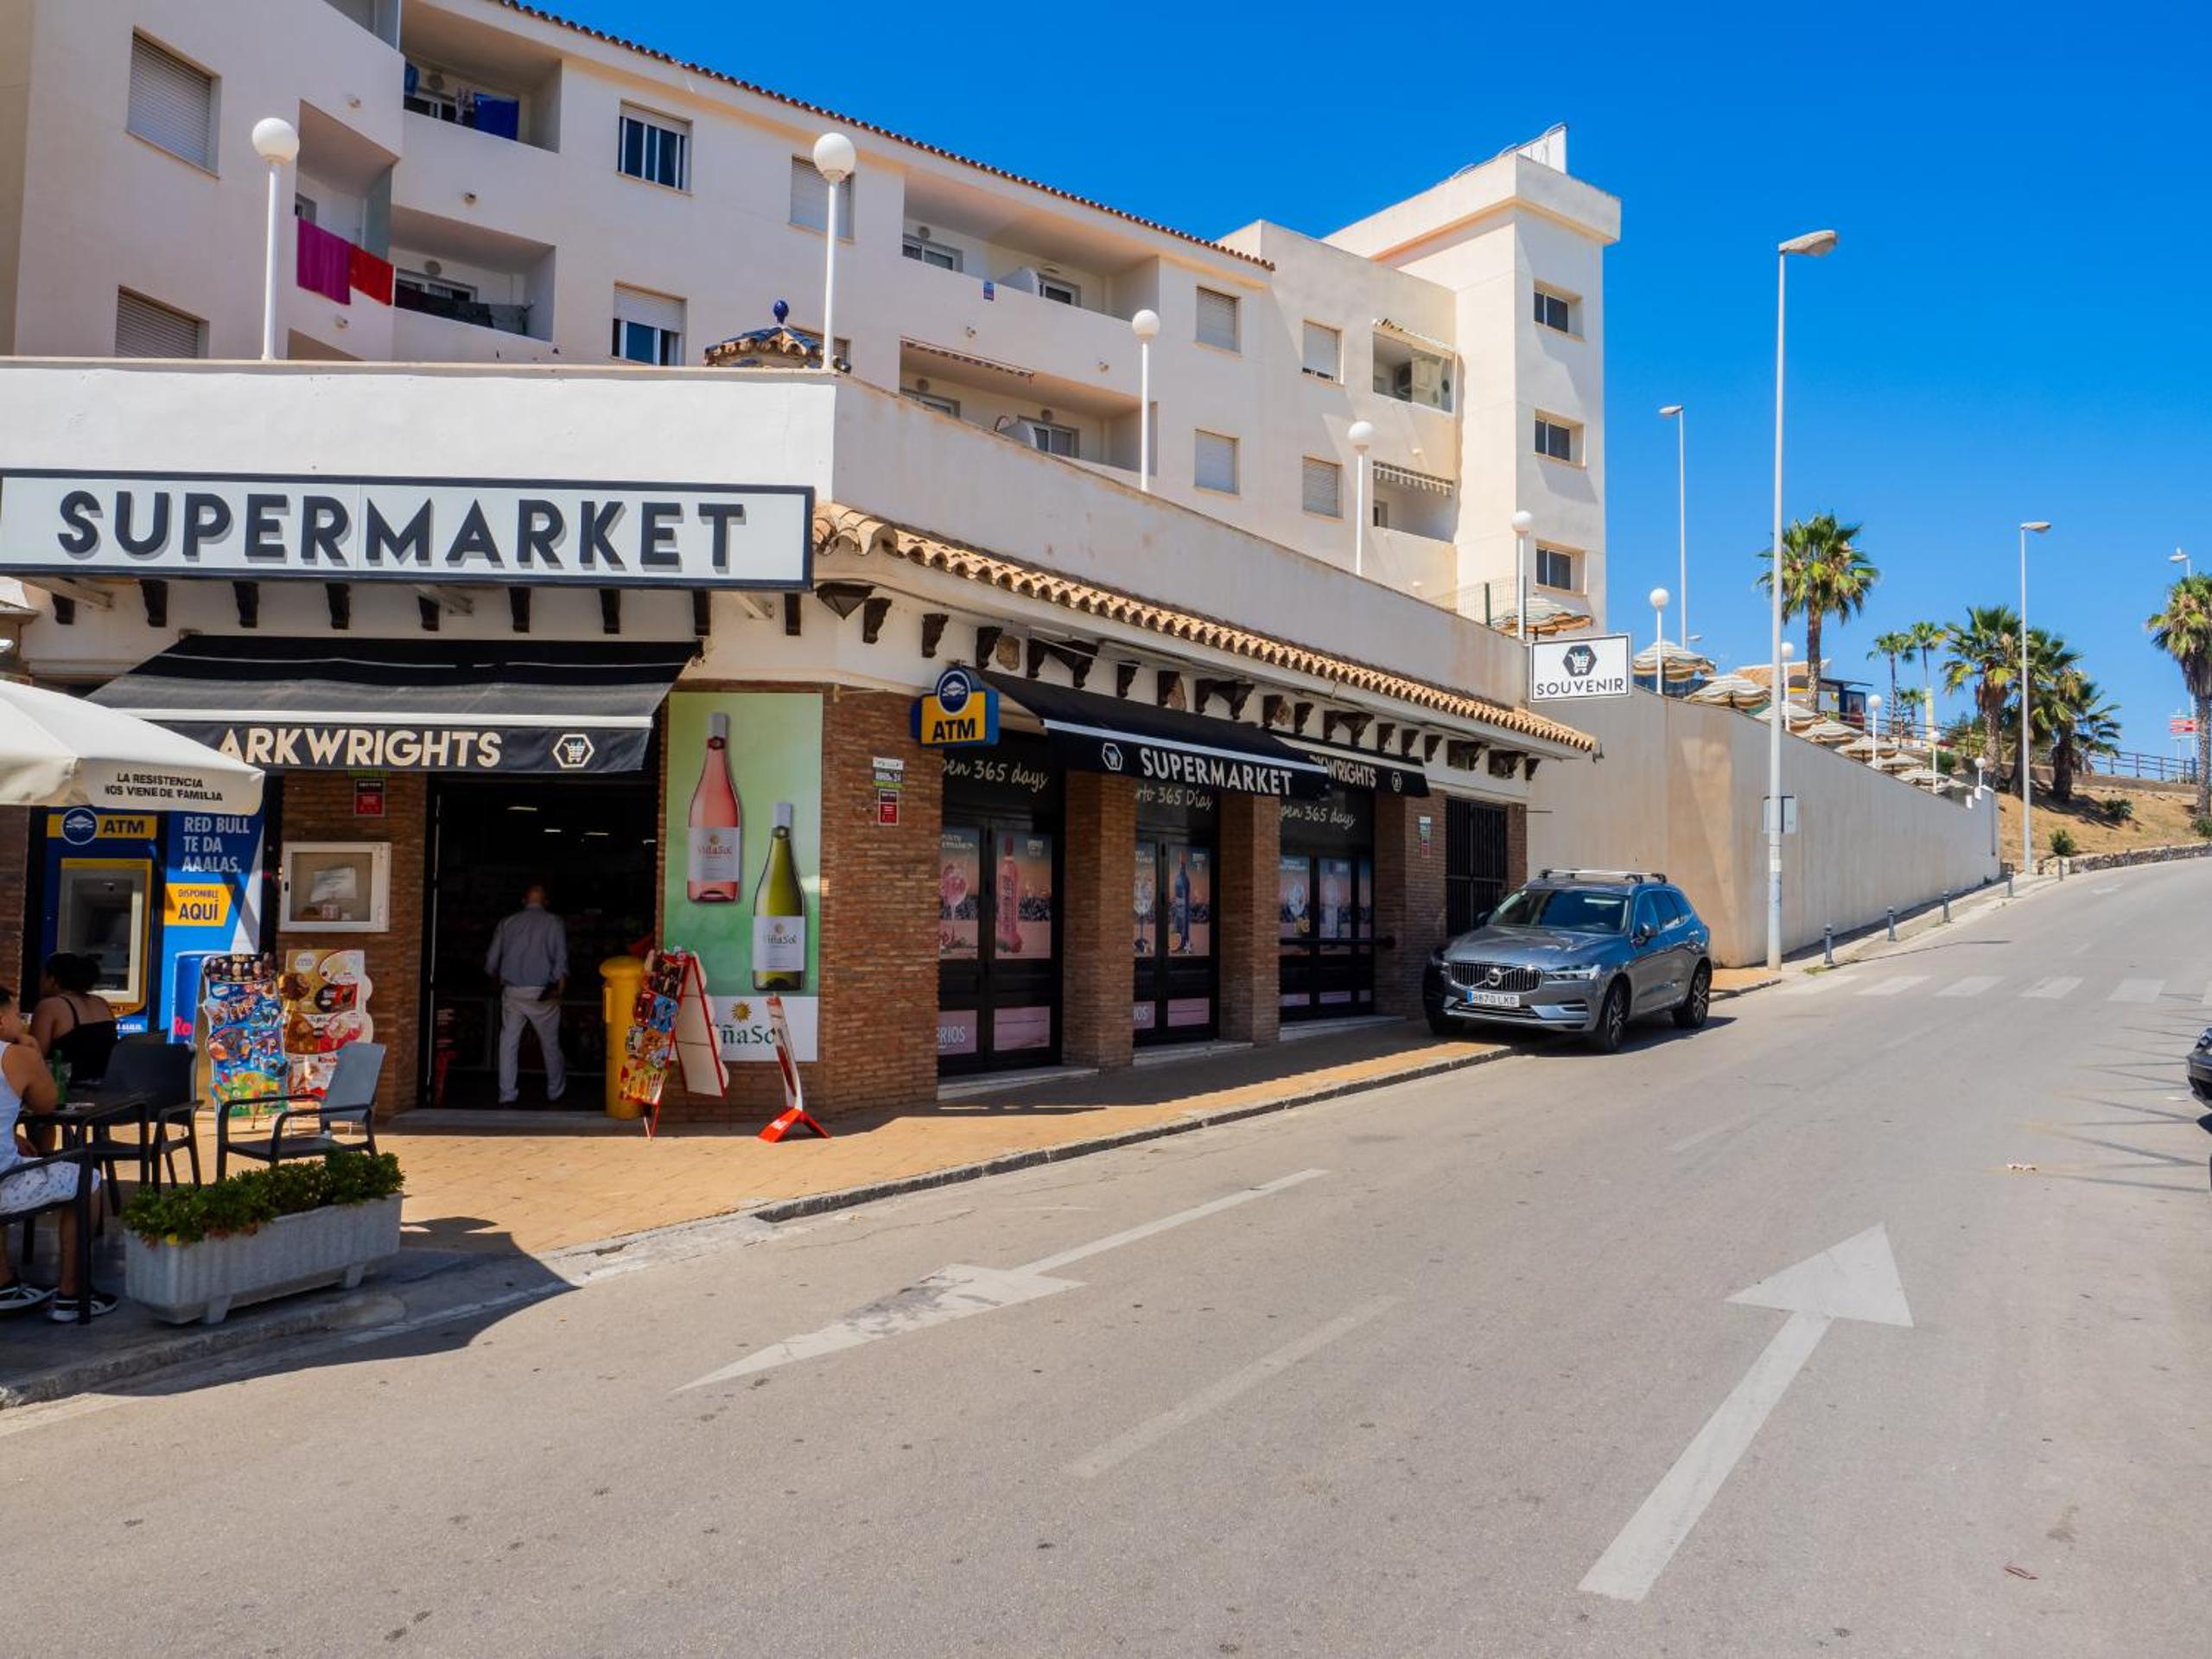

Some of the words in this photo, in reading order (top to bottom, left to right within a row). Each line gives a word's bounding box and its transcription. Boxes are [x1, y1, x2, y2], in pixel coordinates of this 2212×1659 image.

[57, 489, 745, 571] SUPERMARKET
[1536, 677, 1624, 696] SOUVENIR
[932, 718, 976, 742] ATM
[219, 728, 502, 767] ARKWRIGHTS
[117, 773, 130, 783] LA
[132, 774, 203, 788] RESISTENCIA
[974, 760, 1009, 782] 365
[1011, 760, 1050, 792] days
[1140, 747, 1293, 796] SUPERMARKET
[127, 786, 157, 798] VIENE
[160, 788, 173, 798] DE
[177, 789, 223, 802] FAMILIA
[1159, 787, 1183, 805] 365
[103, 819, 145, 834] ATM
[183, 817, 211, 833] RED
[217, 817, 250, 834] BULL
[1305, 805, 1327, 823] 365
[1330, 806, 1357, 830] days
[183, 836, 200, 852] TE
[203, 837, 223, 853] DA
[178, 899, 219, 920] AQUÍ
